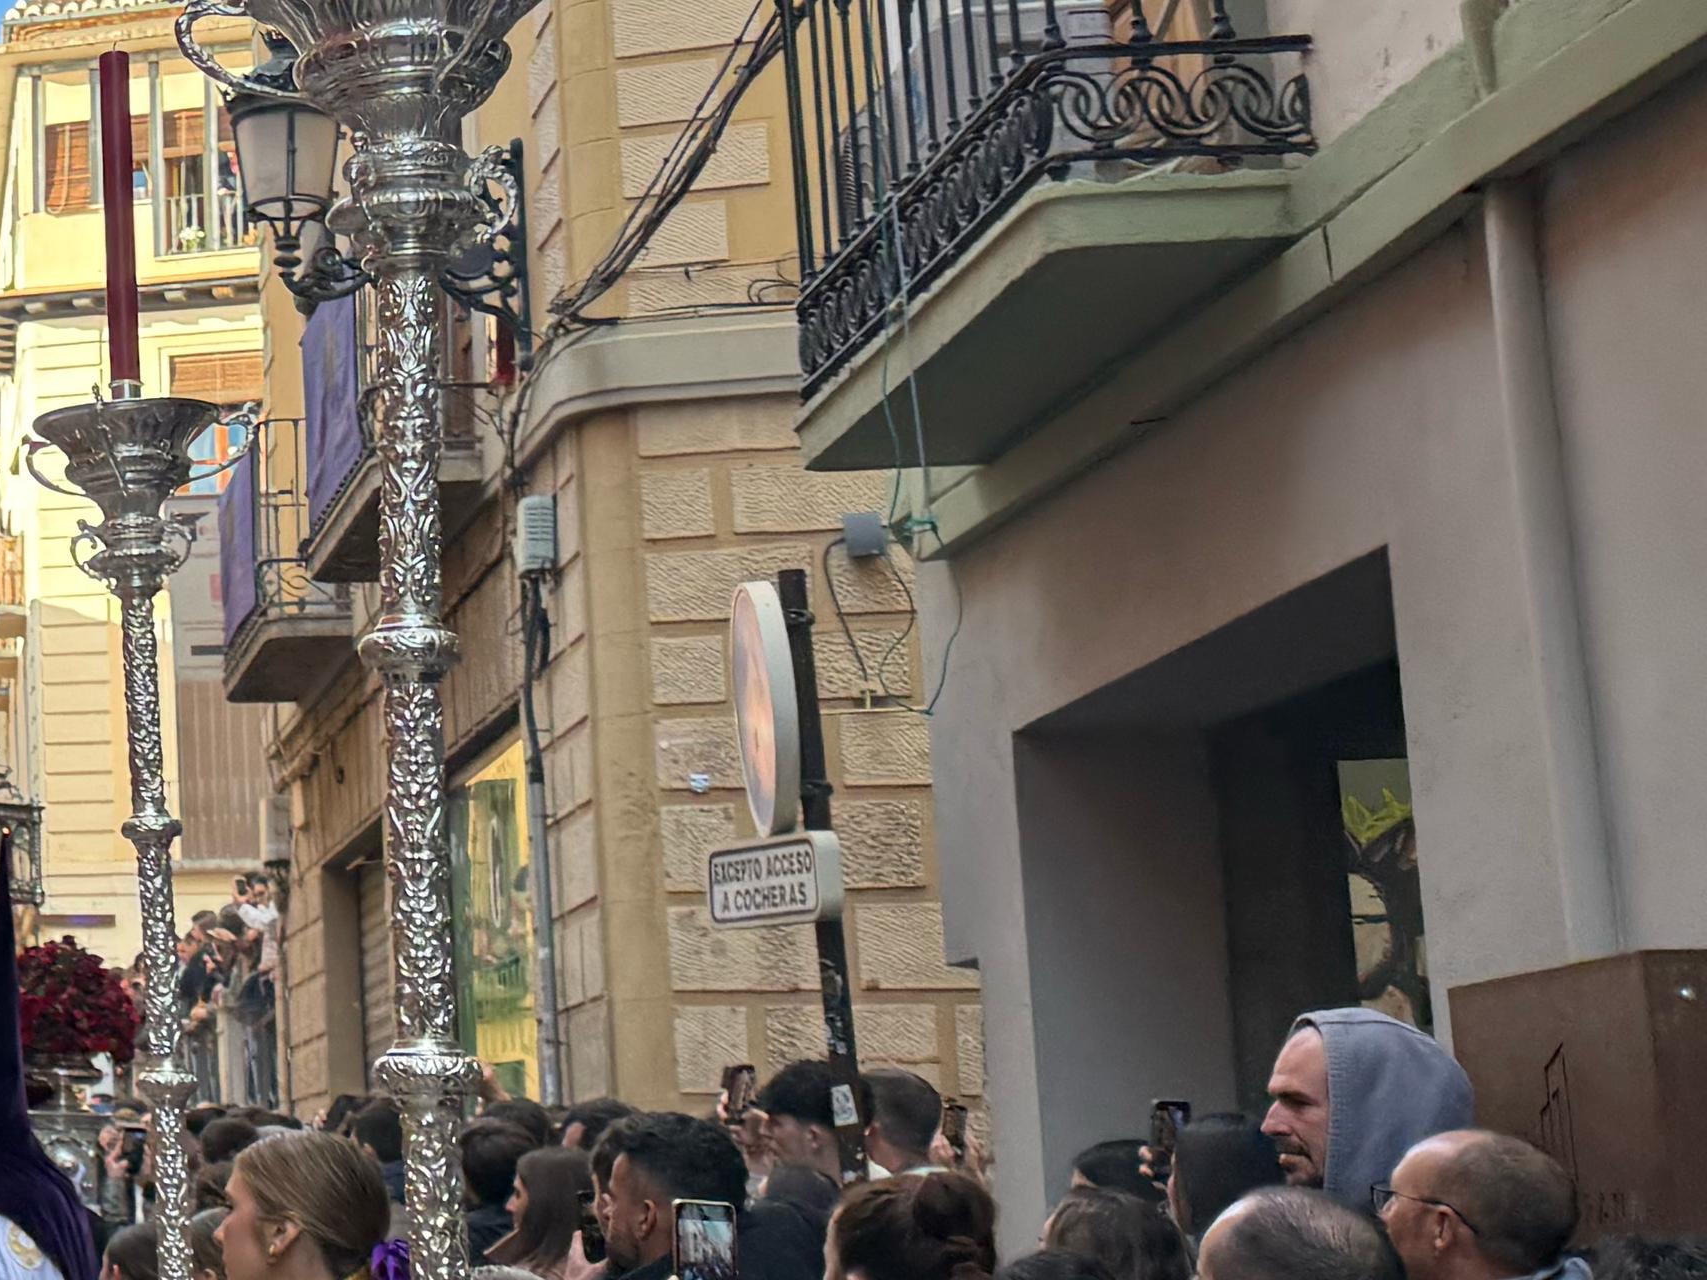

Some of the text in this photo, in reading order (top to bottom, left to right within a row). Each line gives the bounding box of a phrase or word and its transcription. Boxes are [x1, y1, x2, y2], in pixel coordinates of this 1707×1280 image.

[713, 850, 813, 885] EXCEPTO ACCESO
[721, 881, 808, 913] A COCHERAS
